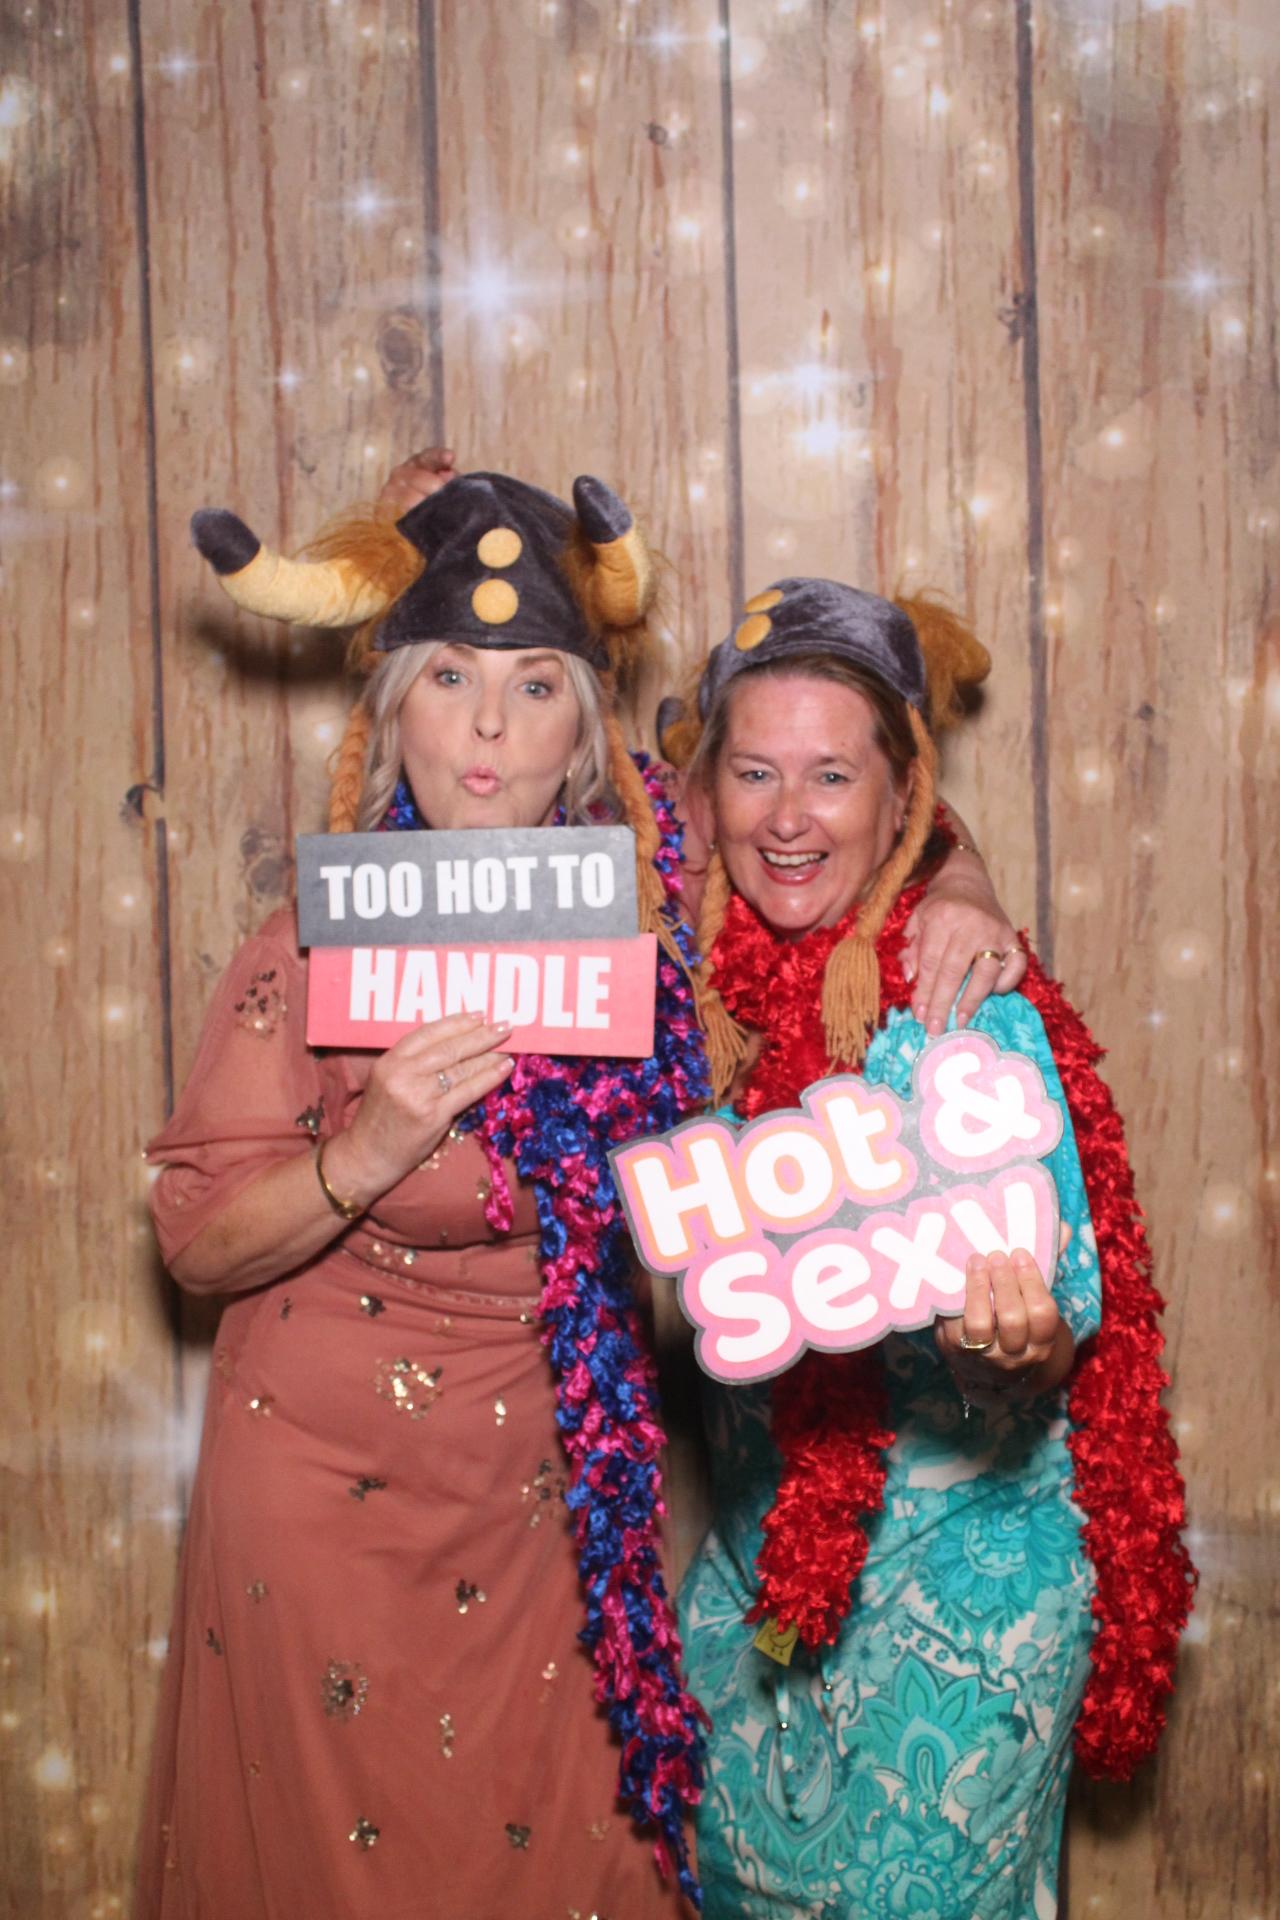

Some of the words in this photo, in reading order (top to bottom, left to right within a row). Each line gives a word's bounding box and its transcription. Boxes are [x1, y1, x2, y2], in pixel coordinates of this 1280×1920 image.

[320, 862, 423, 920] TOO
[436, 857, 538, 915] HOT
[549, 852, 615, 909] TO
[348, 947, 612, 1029] HANDLE
[632, 1095, 902, 1258] Hot
[934, 1052, 1042, 1158] &
